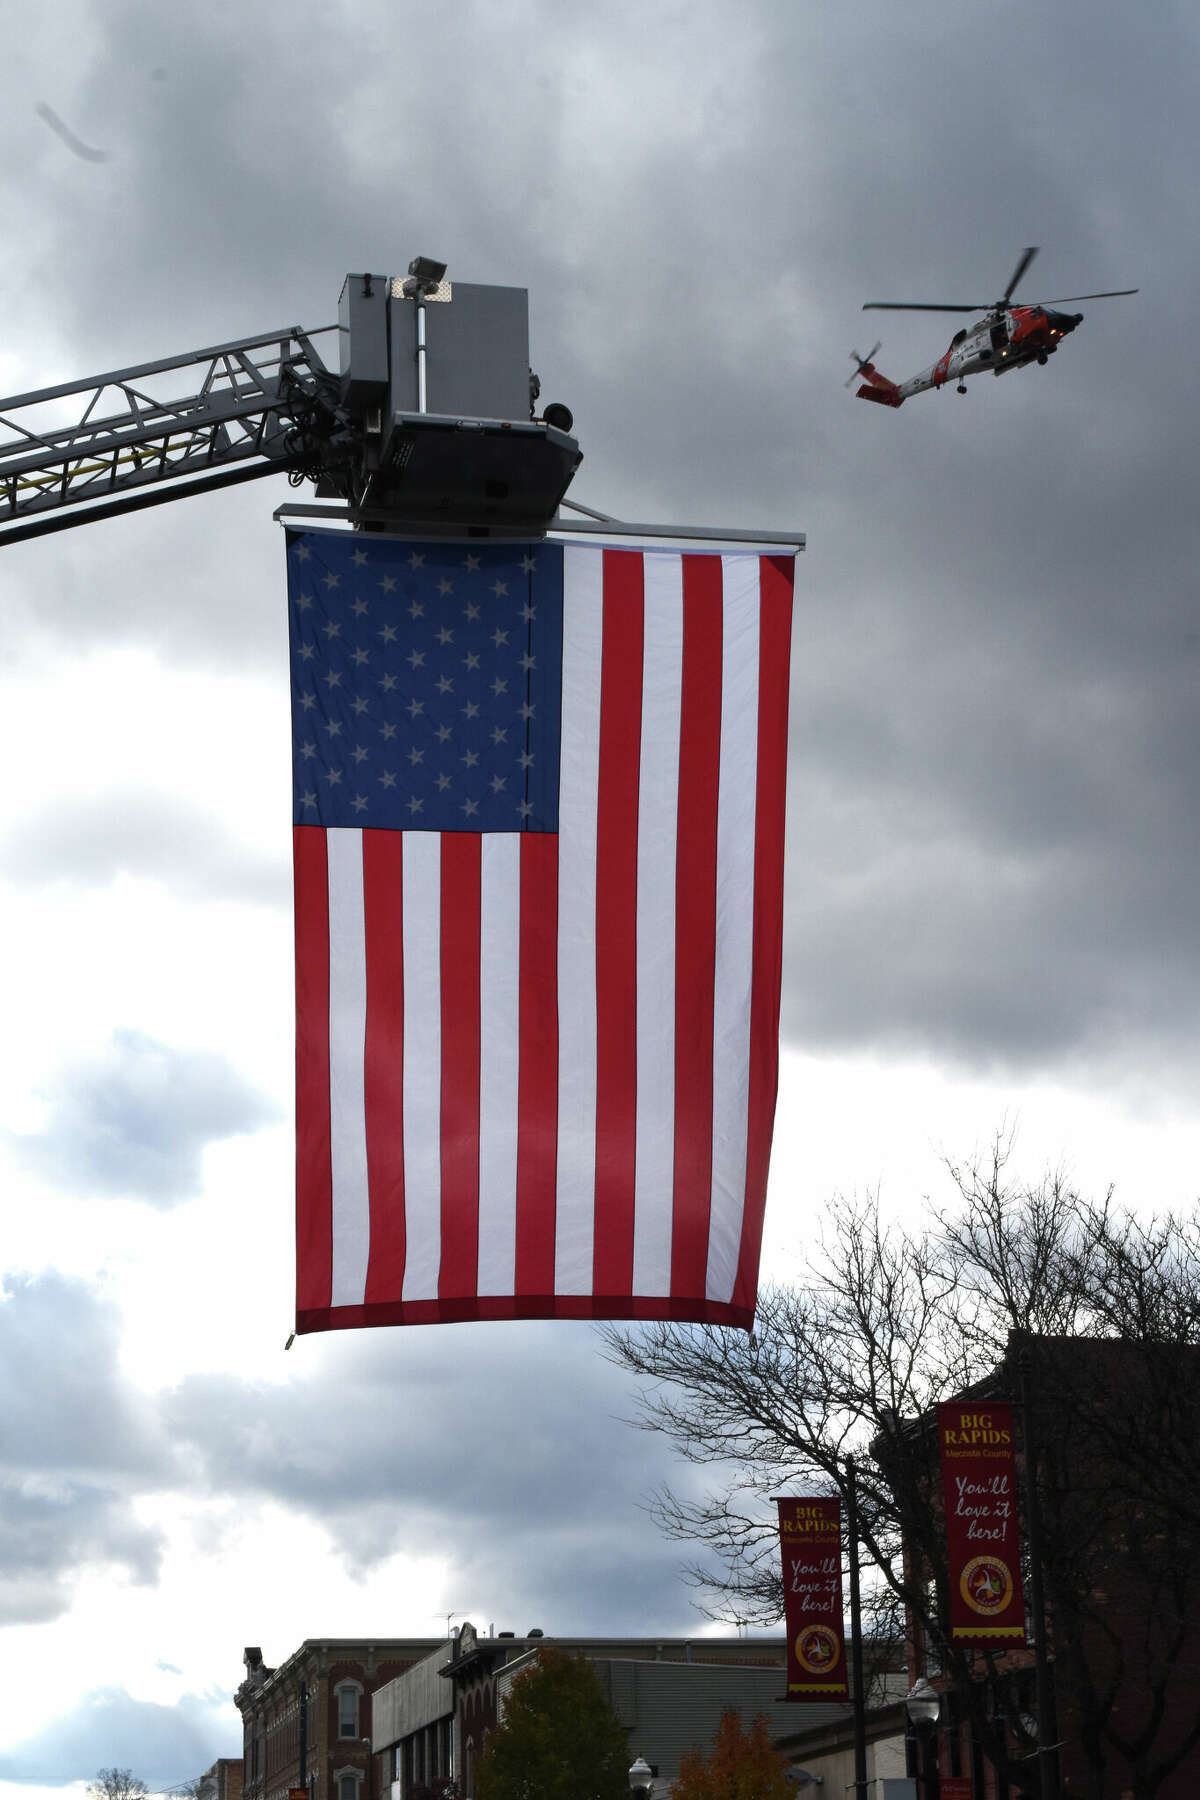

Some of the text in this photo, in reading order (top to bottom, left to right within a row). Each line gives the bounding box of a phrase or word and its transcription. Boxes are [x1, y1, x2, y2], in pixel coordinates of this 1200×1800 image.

[960, 1414, 992, 1428] BIG
[944, 1430, 1011, 1444] RAPIDS
[955, 1475, 1010, 1495] You'll
[796, 1506, 823, 1519] BIG
[954, 1497, 1011, 1518] love it
[783, 1520, 840, 1533] RAPIDS
[967, 1519, 1008, 1542] here!
[791, 1557, 837, 1577] You'll
[791, 1577, 839, 1593] love it
[800, 1594, 835, 1613] here!
